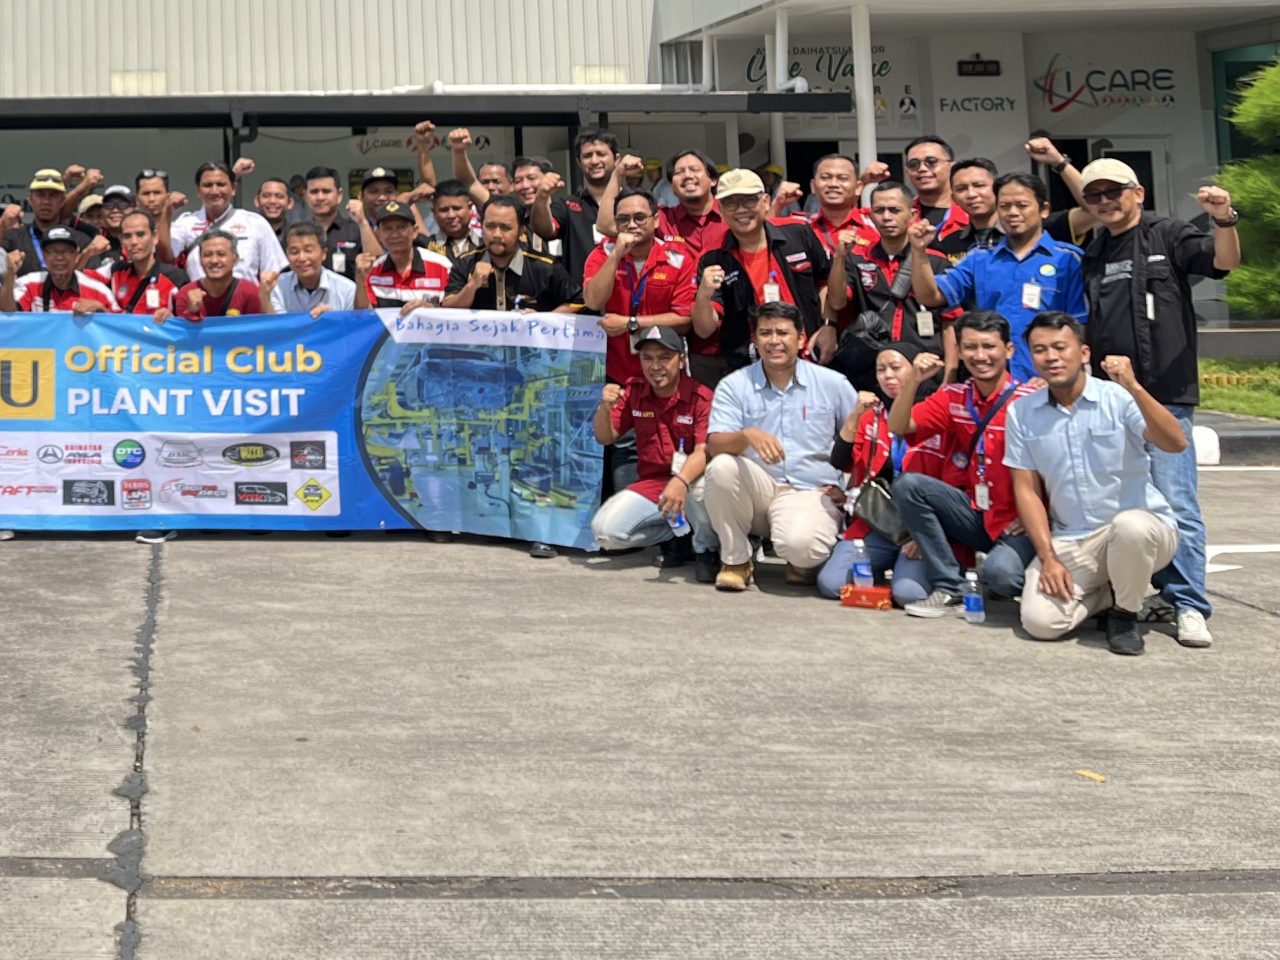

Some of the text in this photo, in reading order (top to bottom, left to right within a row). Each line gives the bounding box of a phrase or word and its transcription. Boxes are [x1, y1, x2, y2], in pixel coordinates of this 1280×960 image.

[793, 46, 845, 56] DAIHATSU
[1086, 68, 1176, 92] CARE
[939, 96, 1017, 113] FACTORY
[395, 317, 605, 340] Bahagia Sejak Pertama
[64, 343, 324, 374] Official Club
[67, 387, 307, 418] PLANT VISIT
